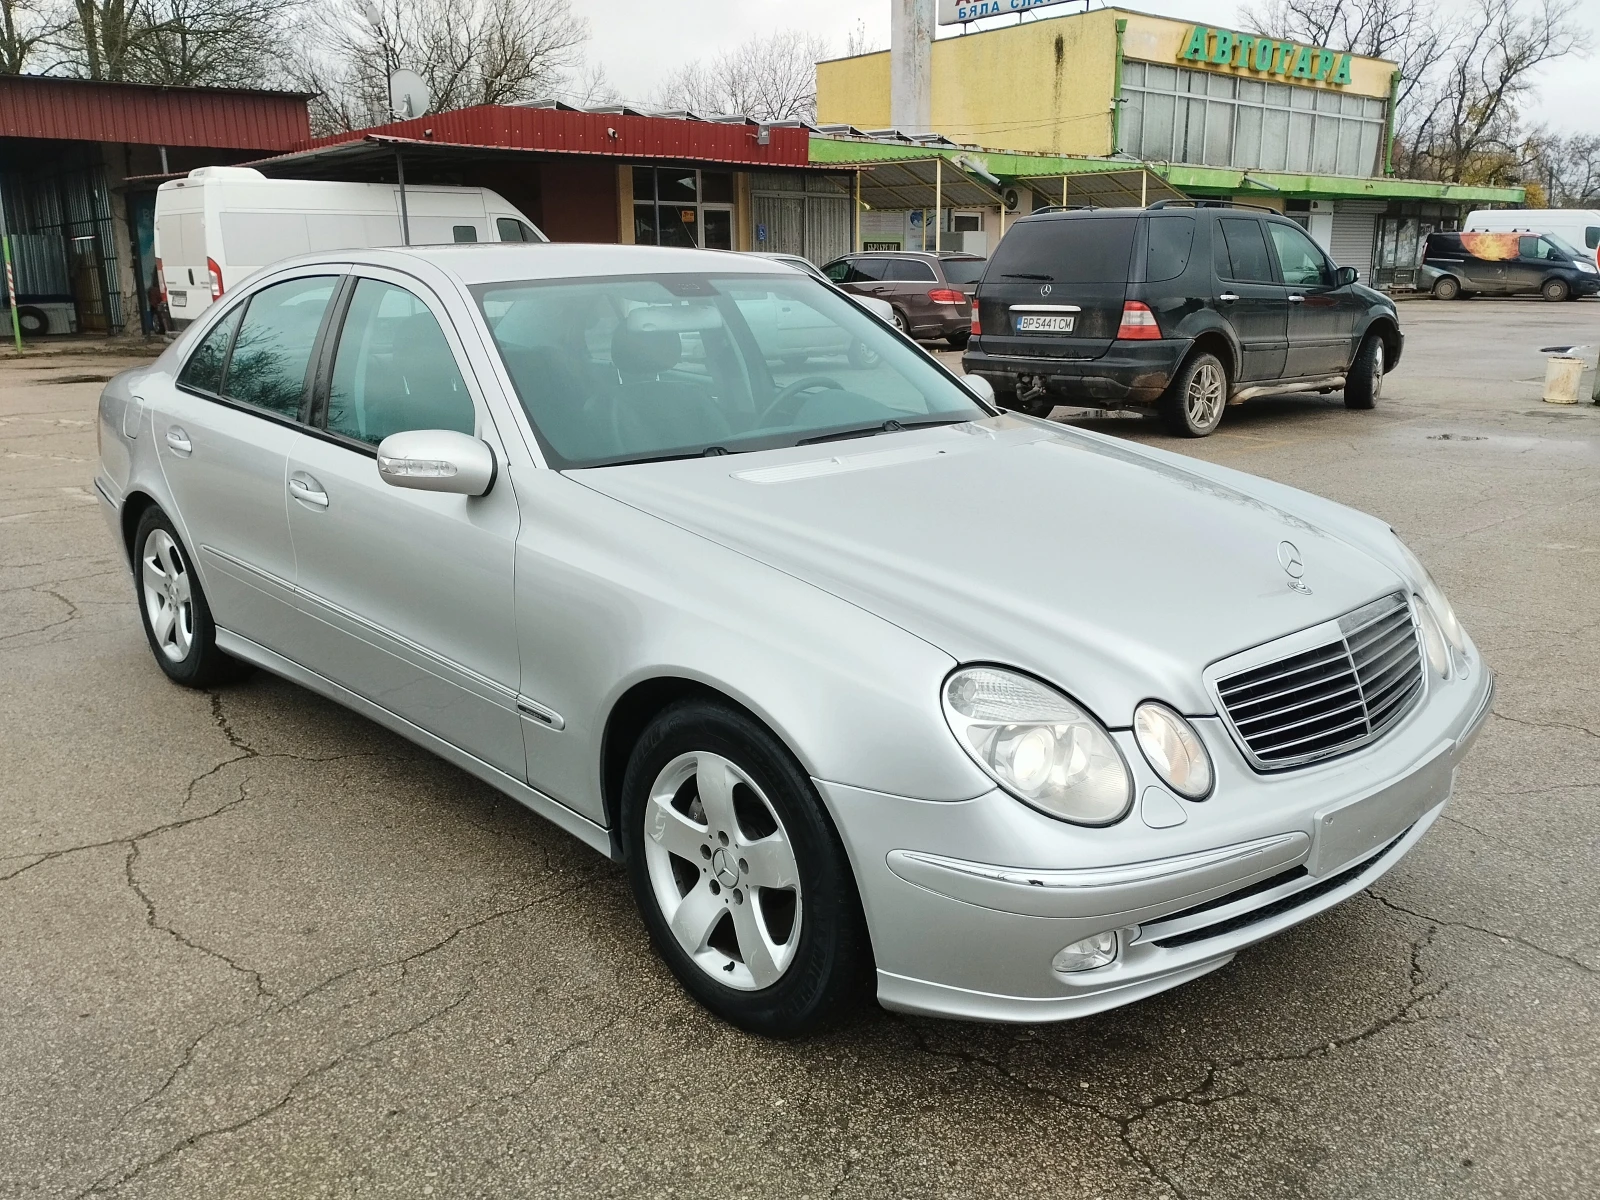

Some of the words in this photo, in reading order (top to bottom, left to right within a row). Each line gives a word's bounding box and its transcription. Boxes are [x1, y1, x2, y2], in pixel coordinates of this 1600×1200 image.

[958, 1, 1000, 19] БЯЛА
[1182, 25, 1352, 85] АВТОГАРА
[1035, 317, 1057, 330] 5441
